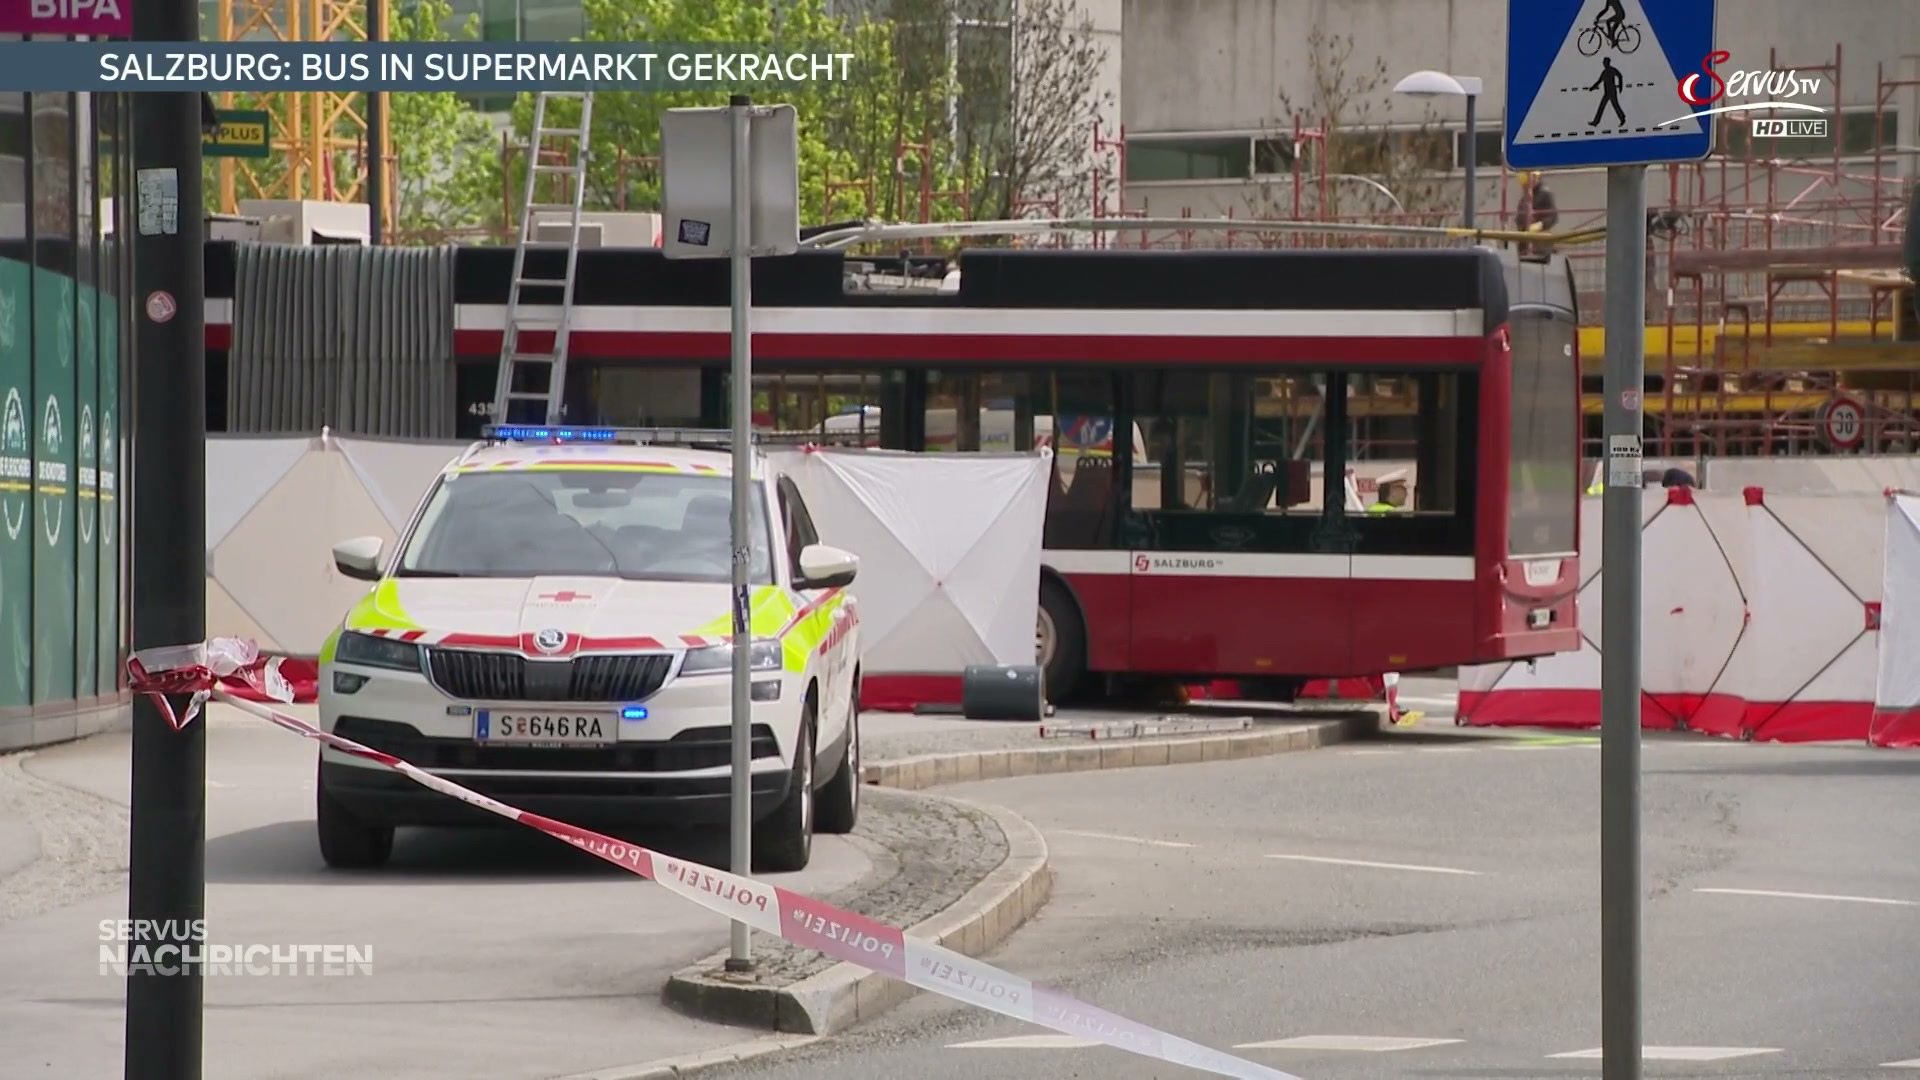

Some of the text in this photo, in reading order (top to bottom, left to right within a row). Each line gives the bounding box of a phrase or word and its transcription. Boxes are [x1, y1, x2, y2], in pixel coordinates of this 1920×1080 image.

[31, 0, 121, 19] BIPA
[221, 127, 260, 140] PLUS
[1836, 411, 1853, 434] 30
[1153, 559, 1215, 568] SALZBURG
[501, 716, 602, 738] S 646 RA
